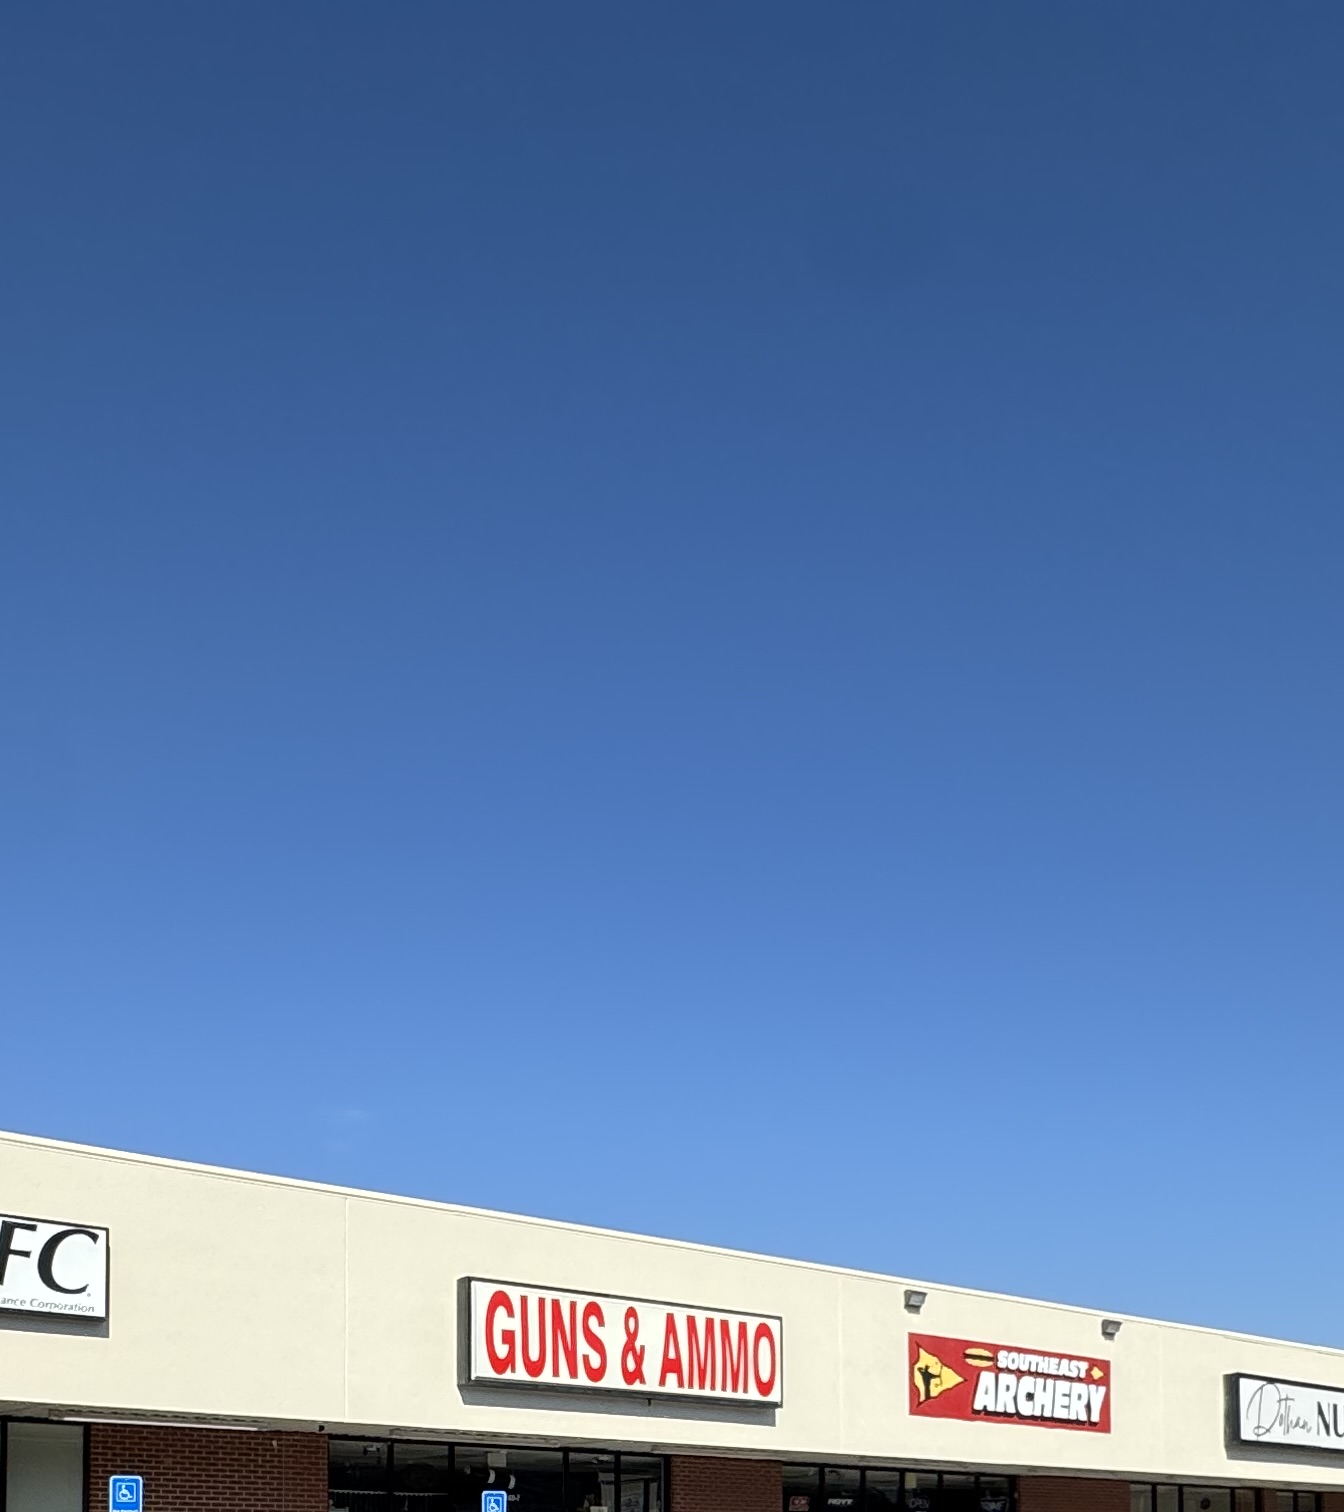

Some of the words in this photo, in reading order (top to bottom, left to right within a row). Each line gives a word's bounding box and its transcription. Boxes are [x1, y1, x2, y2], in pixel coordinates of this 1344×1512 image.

[29, 1298, 96, 1313] Corporation
[485, 1290, 608, 1383] GUNS
[621, 1306, 646, 1386] &
[658, 1312, 776, 1397] AMMO
[996, 1350, 1090, 1379] SOUTHEAST
[972, 1370, 1107, 1425] ARCHERY
